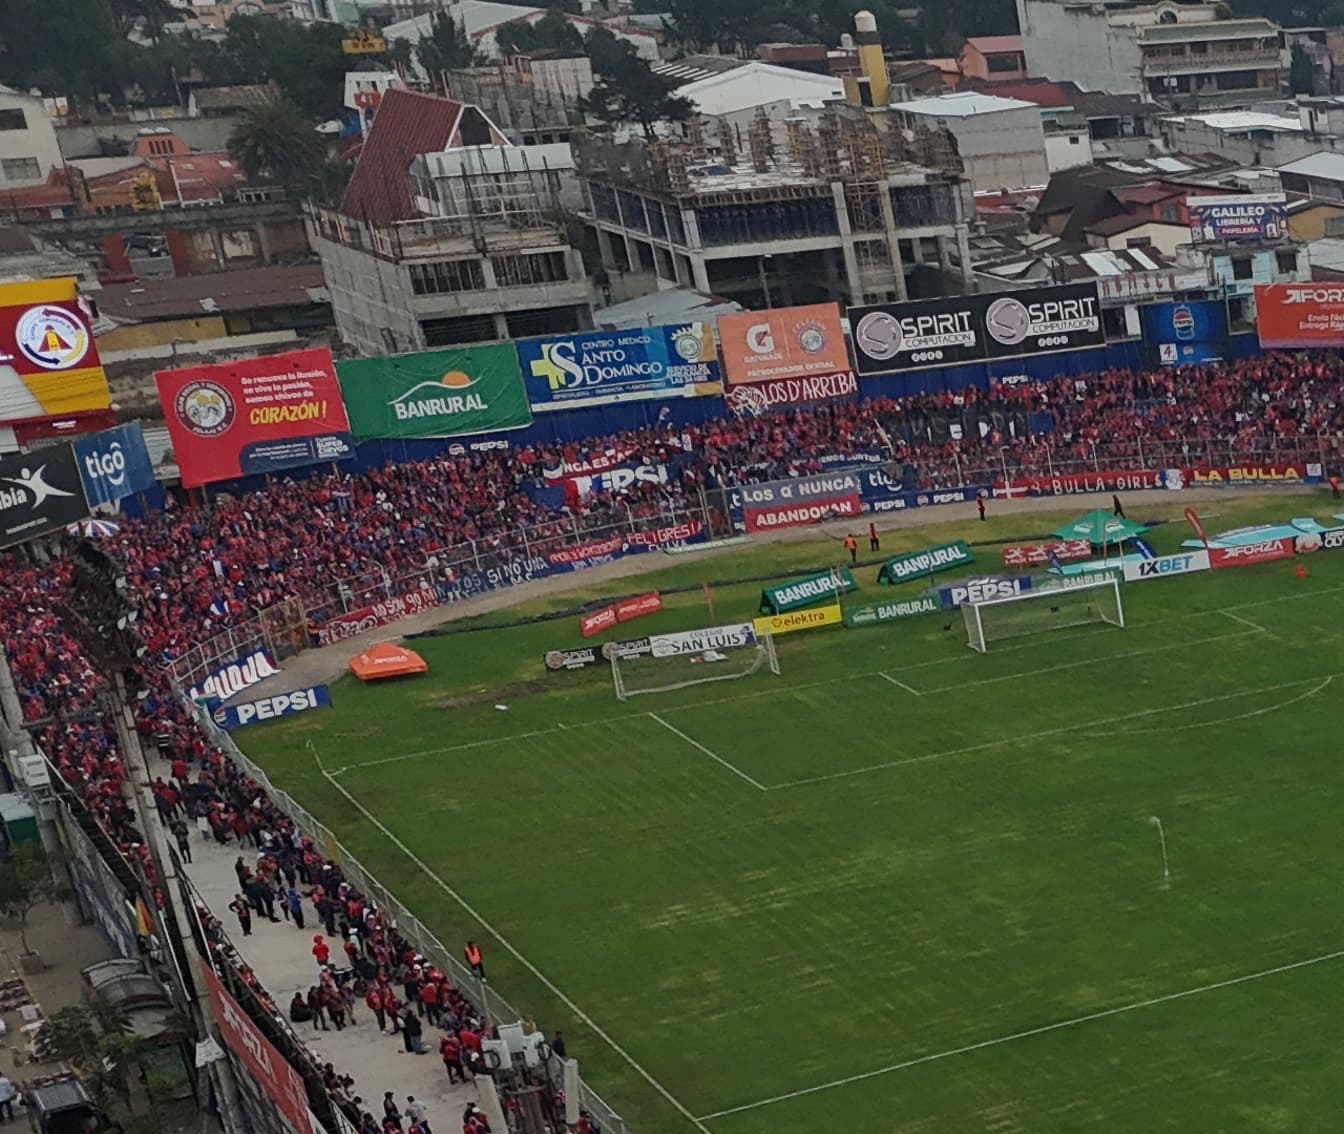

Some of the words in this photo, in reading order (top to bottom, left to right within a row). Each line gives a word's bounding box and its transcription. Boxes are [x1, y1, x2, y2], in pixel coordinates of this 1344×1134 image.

[1211, 206, 1265, 218] GALILEO
[1028, 297, 1096, 323] SPIRIT
[901, 311, 972, 338] SPIRIT
[584, 362, 663, 385] DOMINGO
[1002, 375, 1028, 385] PEPSI
[762, 383, 787, 405] LOS
[394, 392, 489, 421] BANRURAL
[470, 439, 509, 451] PEPSI
[563, 460, 592, 473] NCA
[1193, 470, 1223, 482] LA
[1228, 467, 1300, 480] BULLA
[743, 488, 774, 503] LOS
[799, 477, 855, 496] NUNCA
[933, 492, 964, 504] PEPSI
[1052, 479, 1105, 496] BULLA
[874, 499, 906, 511] PEPSI
[894, 545, 967, 578] BANRURAL
[1138, 555, 1194, 576] 1XBET
[774, 571, 851, 605] BANRURAL
[951, 577, 1021, 605] PEPSI
[784, 610, 824, 627] elektra
[878, 599, 936, 619] BANRURAL
[672, 638, 704, 654] SAN
[708, 633, 740, 652] LUIS
[236, 688, 318, 725] PEPSI
